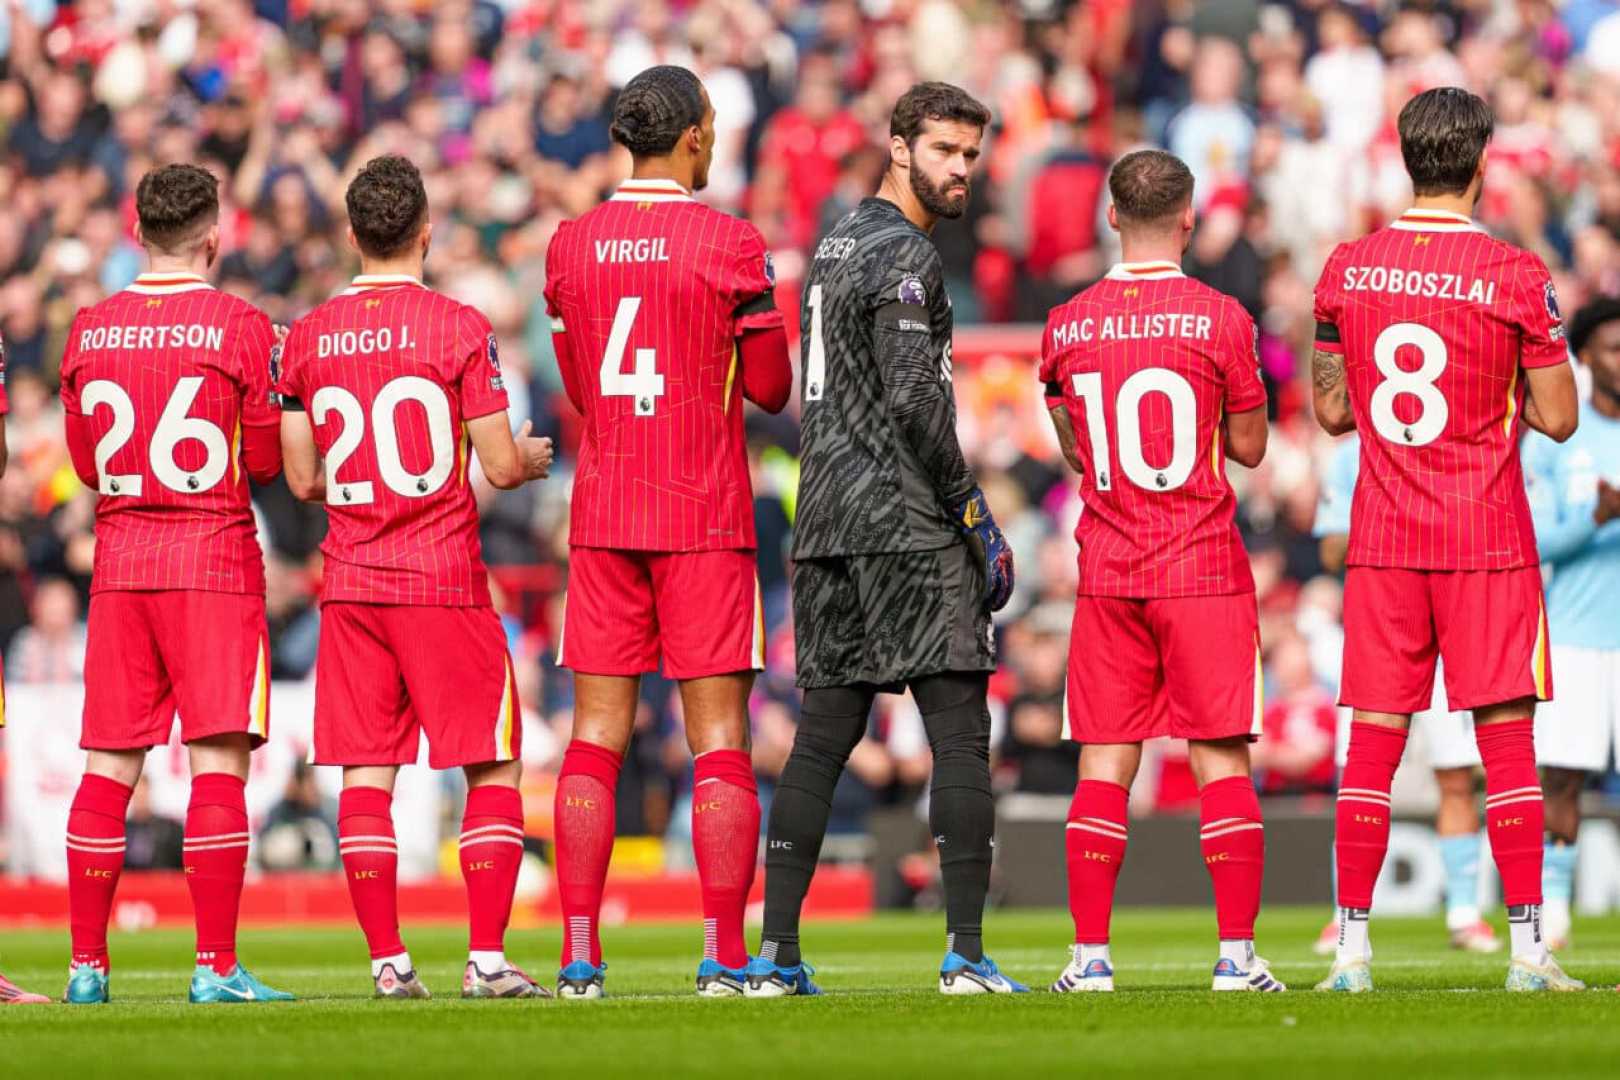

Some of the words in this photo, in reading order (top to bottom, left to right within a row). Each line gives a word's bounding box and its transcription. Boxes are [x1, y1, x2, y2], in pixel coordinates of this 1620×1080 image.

[595, 237, 670, 264] VIRGIL
[1343, 266, 1495, 305] SZOBOSZLAI
[80, 323, 223, 352] ROBERTSON
[318, 327, 392, 359] DIOGO
[398, 325, 417, 350] J.
[805, 284, 826, 401] 1
[1053, 318, 1095, 351] MAC
[1100, 312, 1212, 342] ALLISTER
[600, 297, 665, 416] 4
[1370, 323, 1449, 447] 8
[80, 376, 229, 497] 26
[312, 375, 455, 507] 20
[1071, 367, 1197, 492] 10
[566, 796, 595, 809] LFC
[694, 801, 722, 814] LFC
[1355, 814, 1384, 826] LFC
[1497, 816, 1524, 829] LFC
[770, 839, 794, 850] LFC
[1084, 850, 1111, 863] LFC
[1205, 852, 1230, 864] LFC
[85, 867, 113, 879] LFC
[355, 870, 379, 880] LFC
[469, 860, 494, 871] LFC
